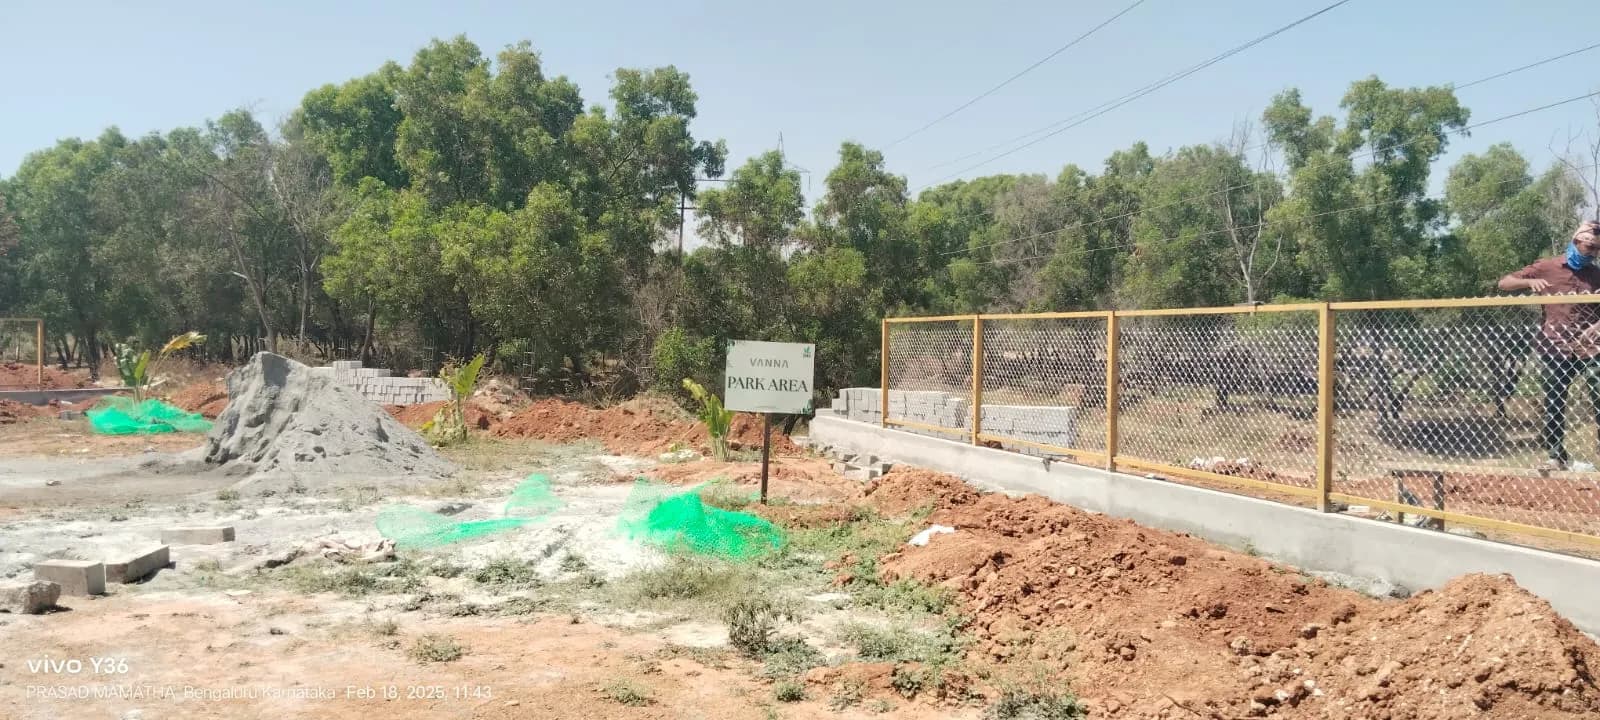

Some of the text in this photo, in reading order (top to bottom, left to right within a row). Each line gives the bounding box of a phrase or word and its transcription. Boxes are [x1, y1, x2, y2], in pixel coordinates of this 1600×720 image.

[750, 358, 789, 368] VANNA
[728, 376, 808, 392] PARK AREA
